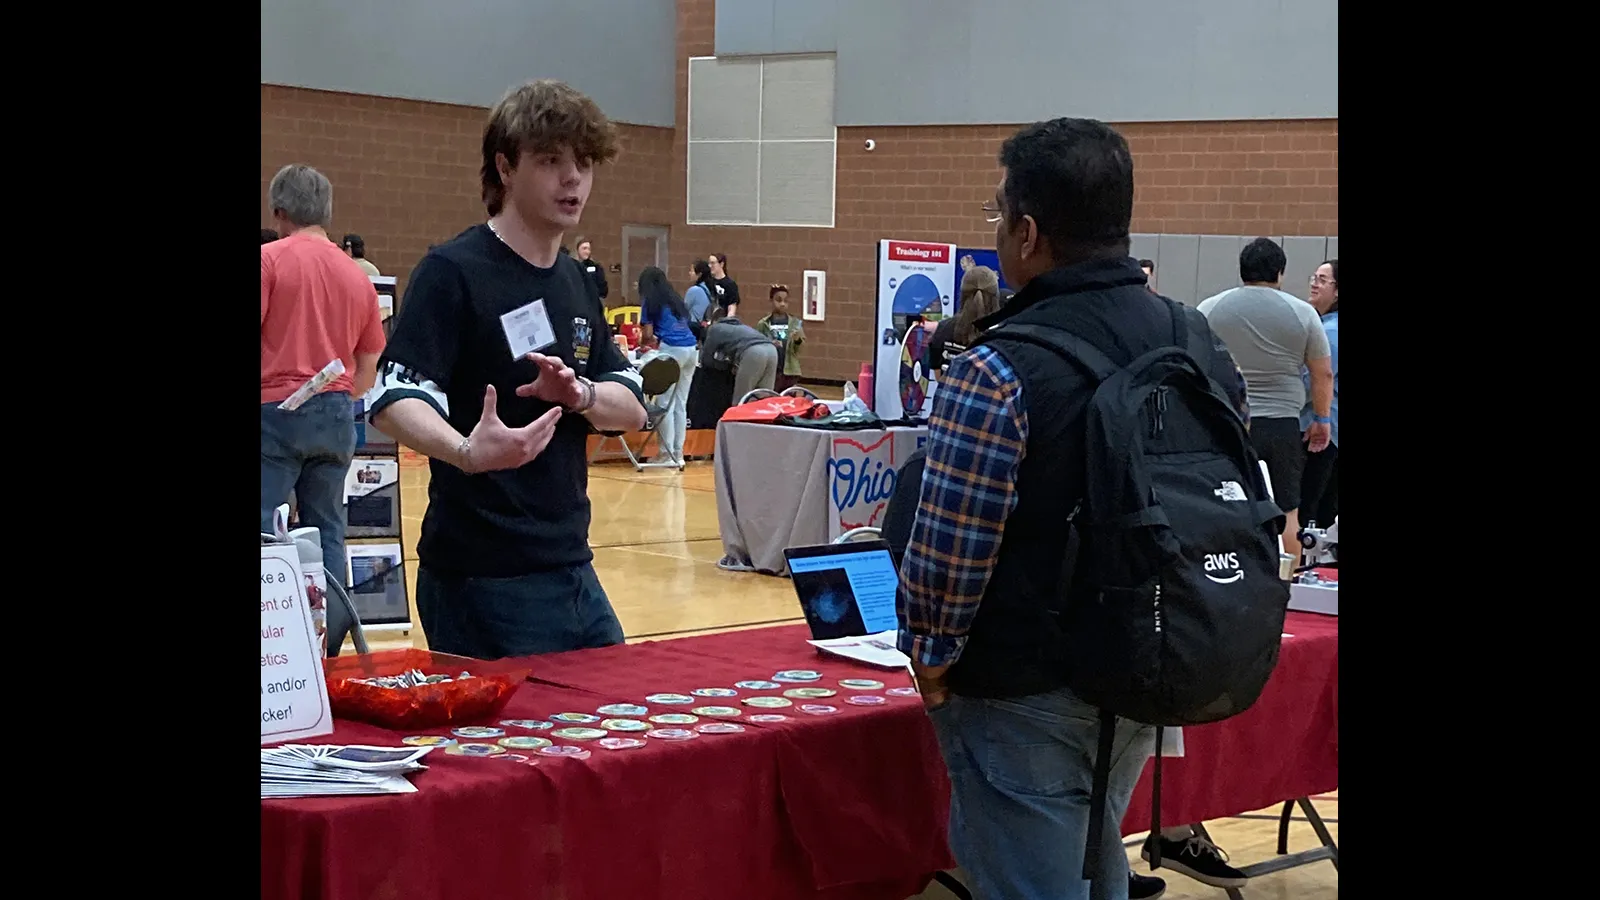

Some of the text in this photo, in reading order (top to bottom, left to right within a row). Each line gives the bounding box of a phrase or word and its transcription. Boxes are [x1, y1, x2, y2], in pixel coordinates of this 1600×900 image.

[896, 246, 942, 259] Trashology 101
[827, 457, 897, 513] Ohio
[1204, 552, 1240, 571] aws
[277, 572, 286, 583] a
[281, 595, 293, 610] of
[267, 677, 307, 694] and/or
